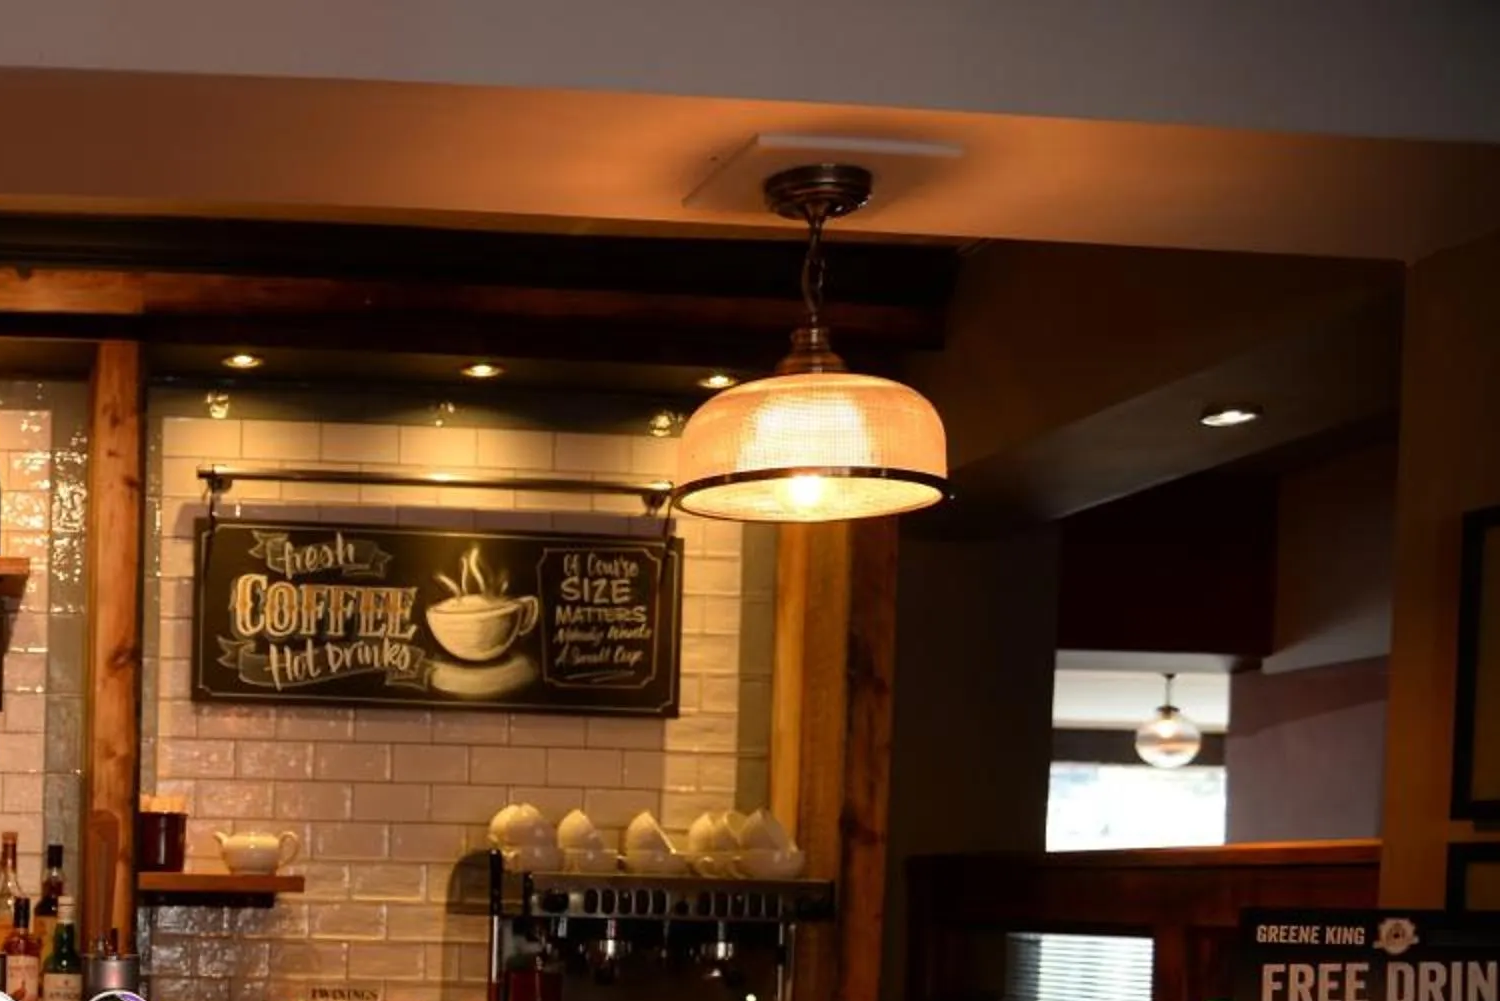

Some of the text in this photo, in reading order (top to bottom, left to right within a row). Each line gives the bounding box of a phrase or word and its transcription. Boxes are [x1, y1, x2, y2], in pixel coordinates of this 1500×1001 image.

[560, 576, 632, 605] SIZE
[555, 604, 648, 626] MATTERS
[1256, 924, 1366, 945] GREENE KING
